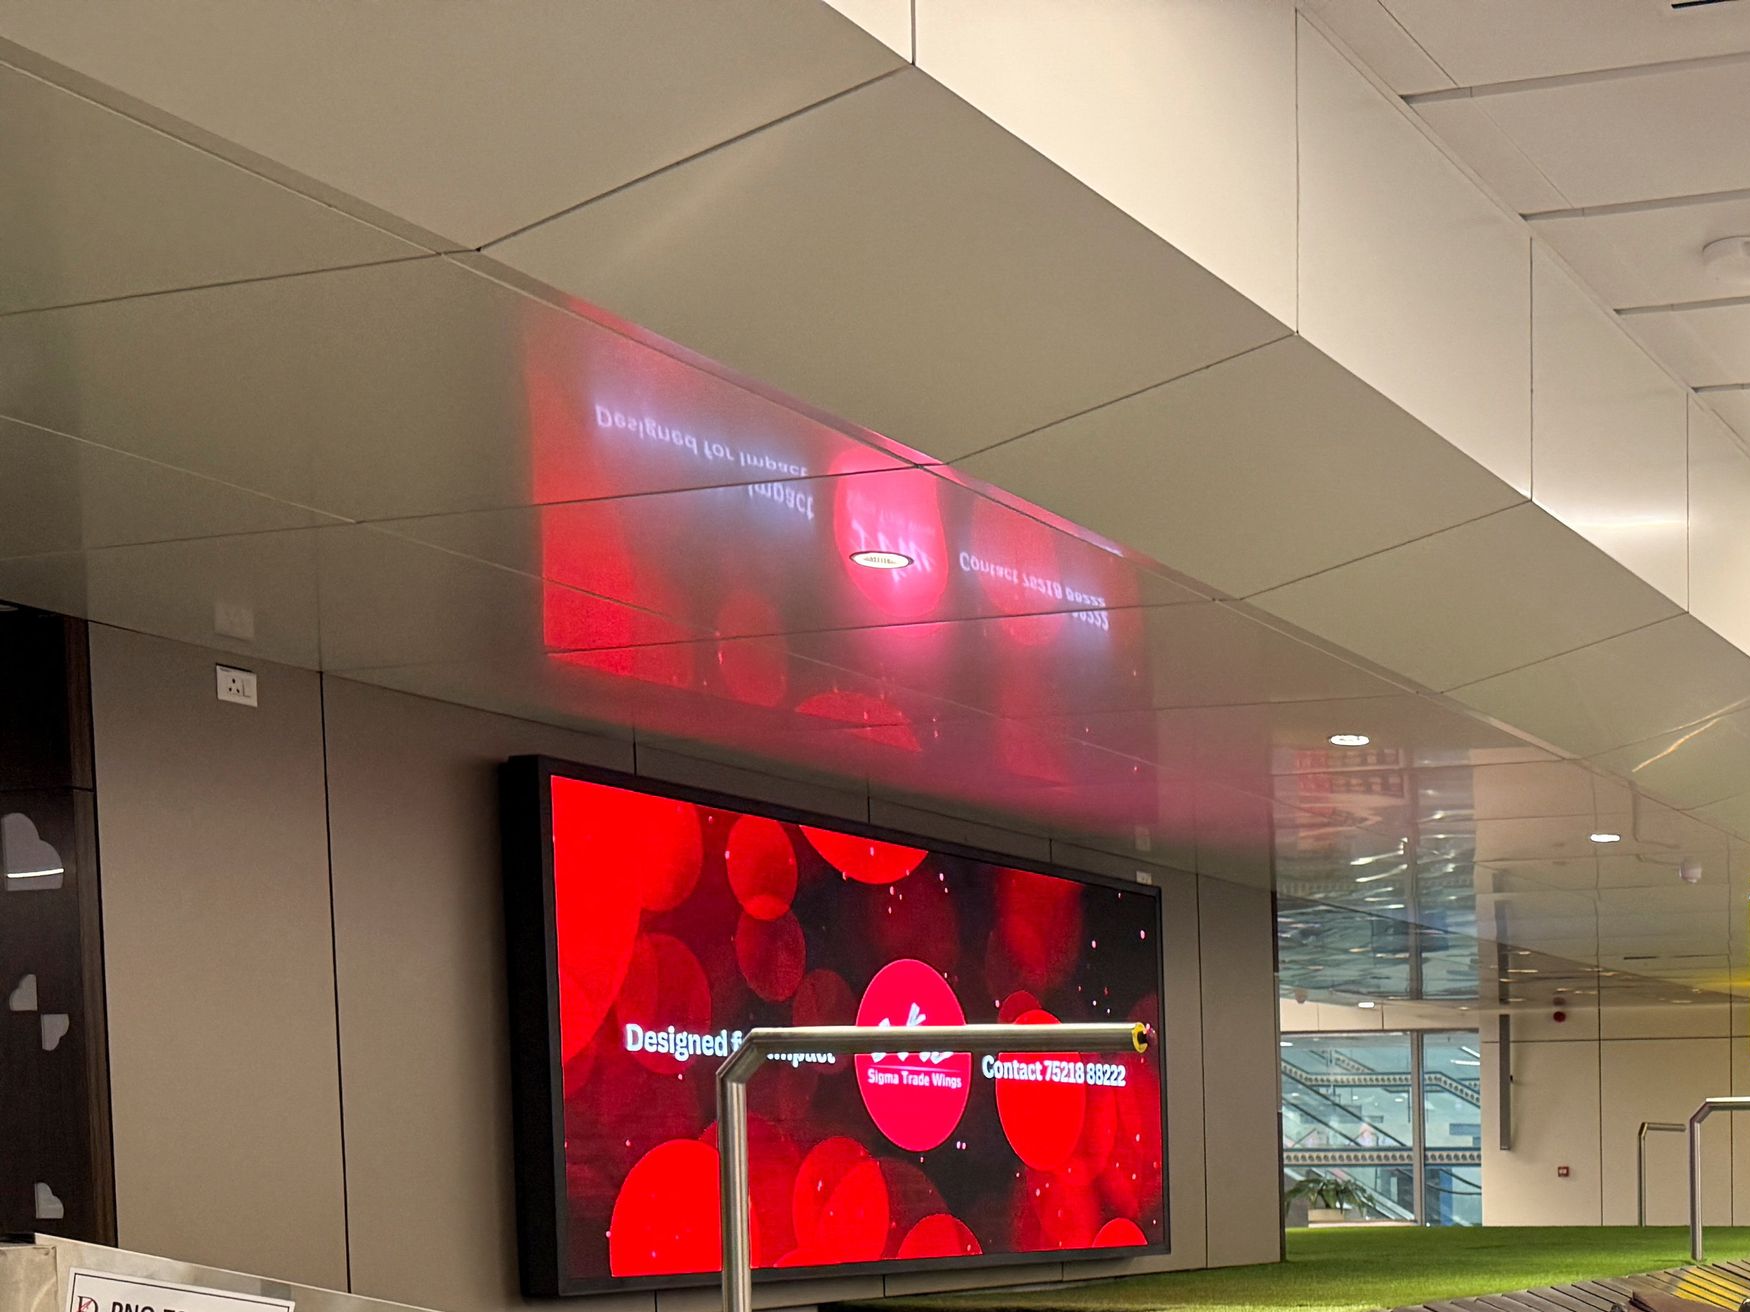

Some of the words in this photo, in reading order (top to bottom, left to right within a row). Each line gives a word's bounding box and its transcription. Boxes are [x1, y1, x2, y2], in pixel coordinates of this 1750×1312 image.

[626, 1023, 728, 1061] Designed
[867, 1068, 899, 1085] Sigma
[901, 1071, 930, 1087] Trade
[932, 1073, 962, 1089] Wings
[982, 1055, 1043, 1081] Contact
[1044, 1060, 1085, 1084] 75218
[1086, 1063, 1126, 1087] 88222
